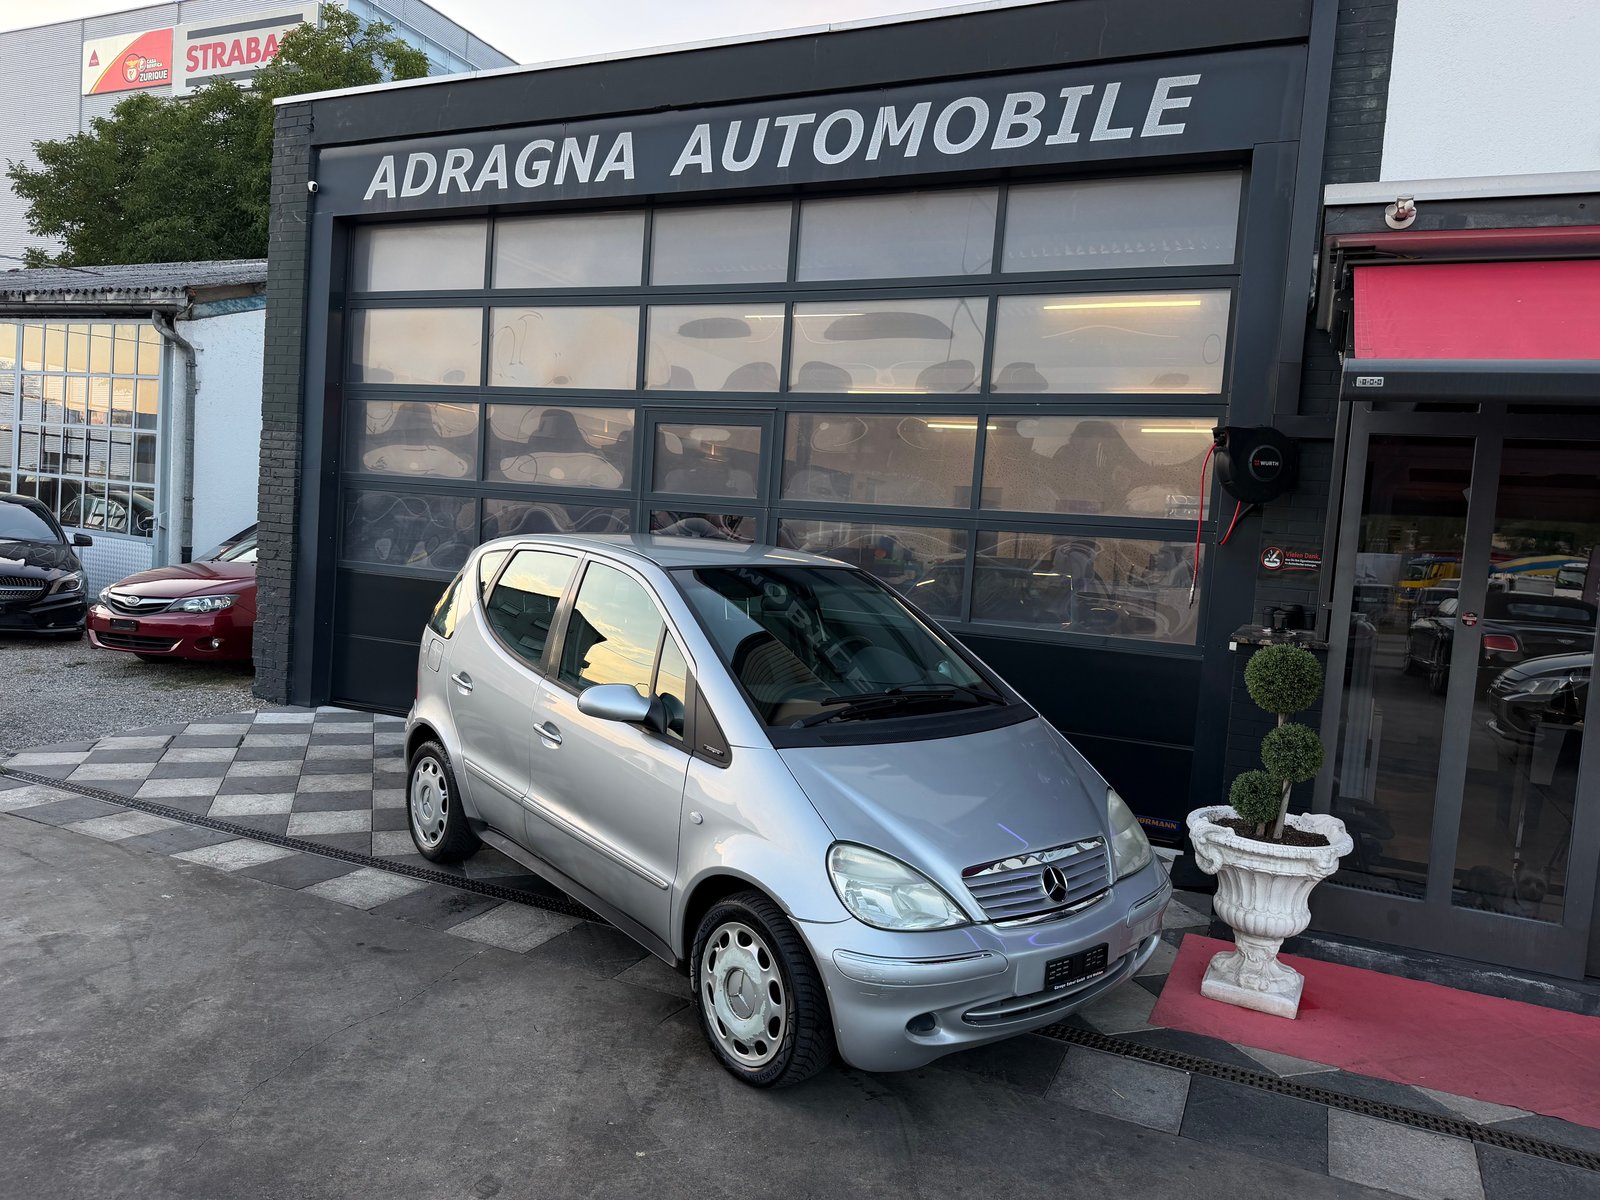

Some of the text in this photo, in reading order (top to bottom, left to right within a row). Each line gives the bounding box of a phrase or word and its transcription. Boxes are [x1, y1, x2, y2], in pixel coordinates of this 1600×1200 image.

[185, 30, 294, 73] STRABA
[139, 69, 168, 82] ZURIQUE
[364, 74, 1201, 200] ADRAGNA AUTOMOBILE
